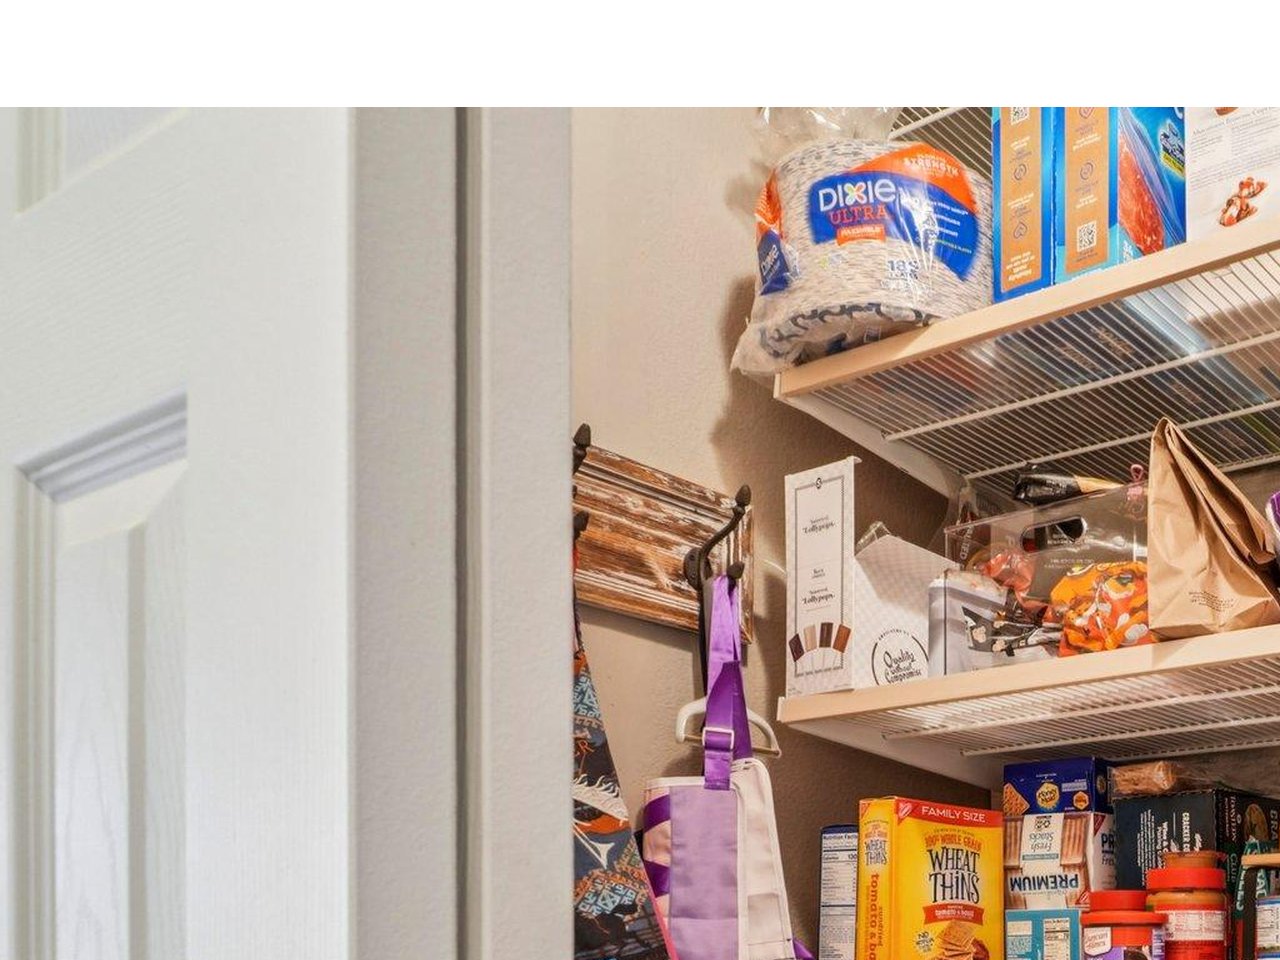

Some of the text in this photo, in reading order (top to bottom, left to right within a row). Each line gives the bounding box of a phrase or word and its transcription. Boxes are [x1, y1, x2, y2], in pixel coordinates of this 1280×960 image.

[818, 178, 897, 212] DIXIE
[829, 205, 889, 225] ULTRA
[883, 649, 915, 668] Quality
[921, 805, 986, 823] FAMILY SIZE
[927, 846, 980, 874] WHEAT
[1010, 874, 1079, 891] PREMIUM
[869, 873, 880, 928] tomato
